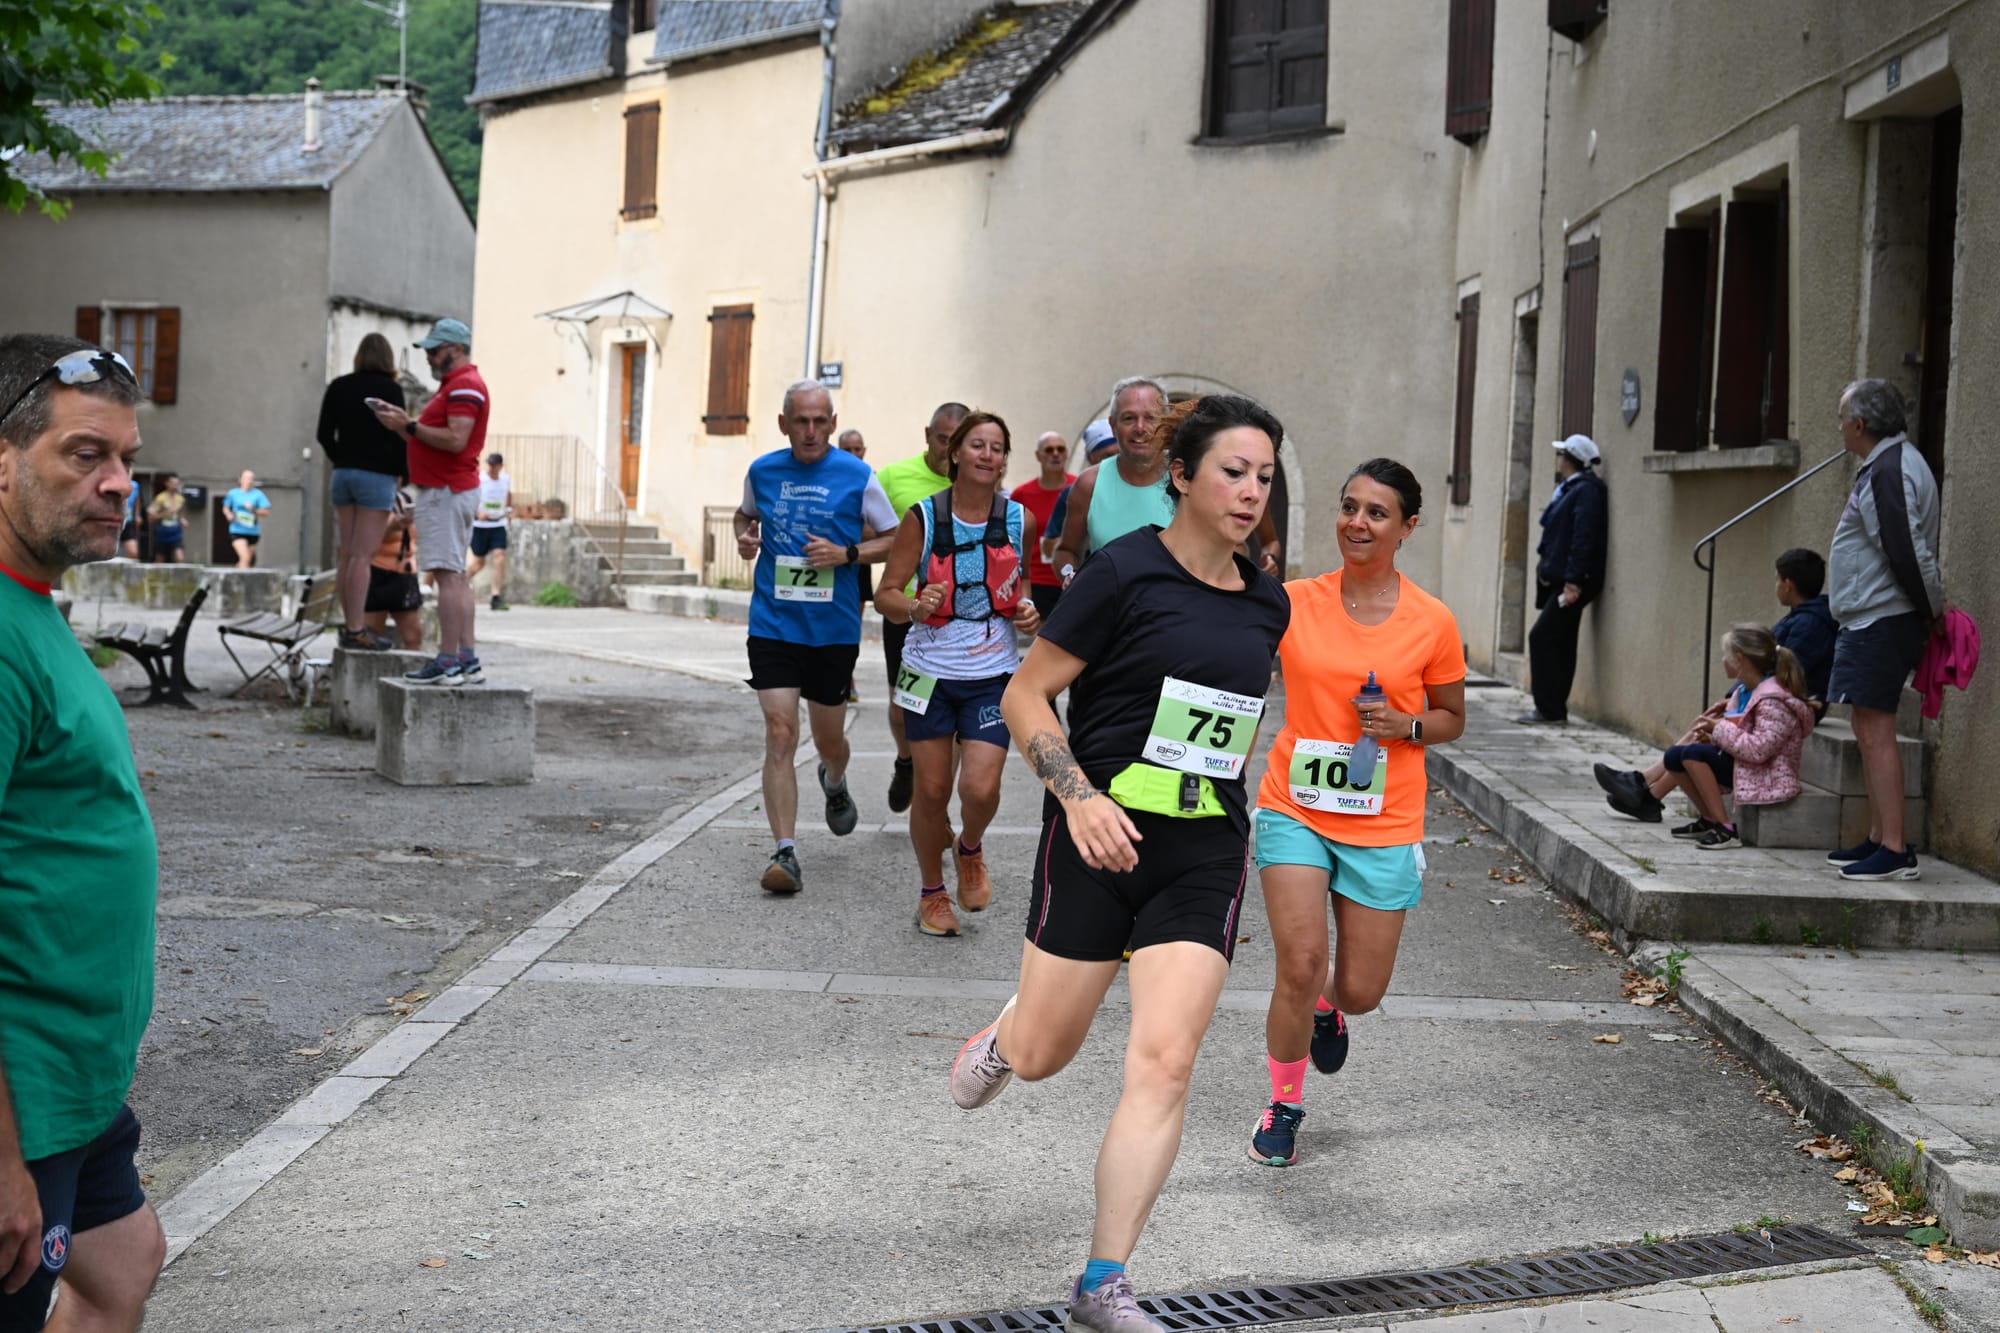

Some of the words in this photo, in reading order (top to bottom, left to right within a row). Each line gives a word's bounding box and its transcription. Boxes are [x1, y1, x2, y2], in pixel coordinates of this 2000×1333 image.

[789, 568, 818, 587] 72
[1186, 708, 1236, 749] 75
[1156, 745, 1182, 757] BFP
[1304, 758, 1372, 791] 10
[1296, 791, 1317, 800] BFP
